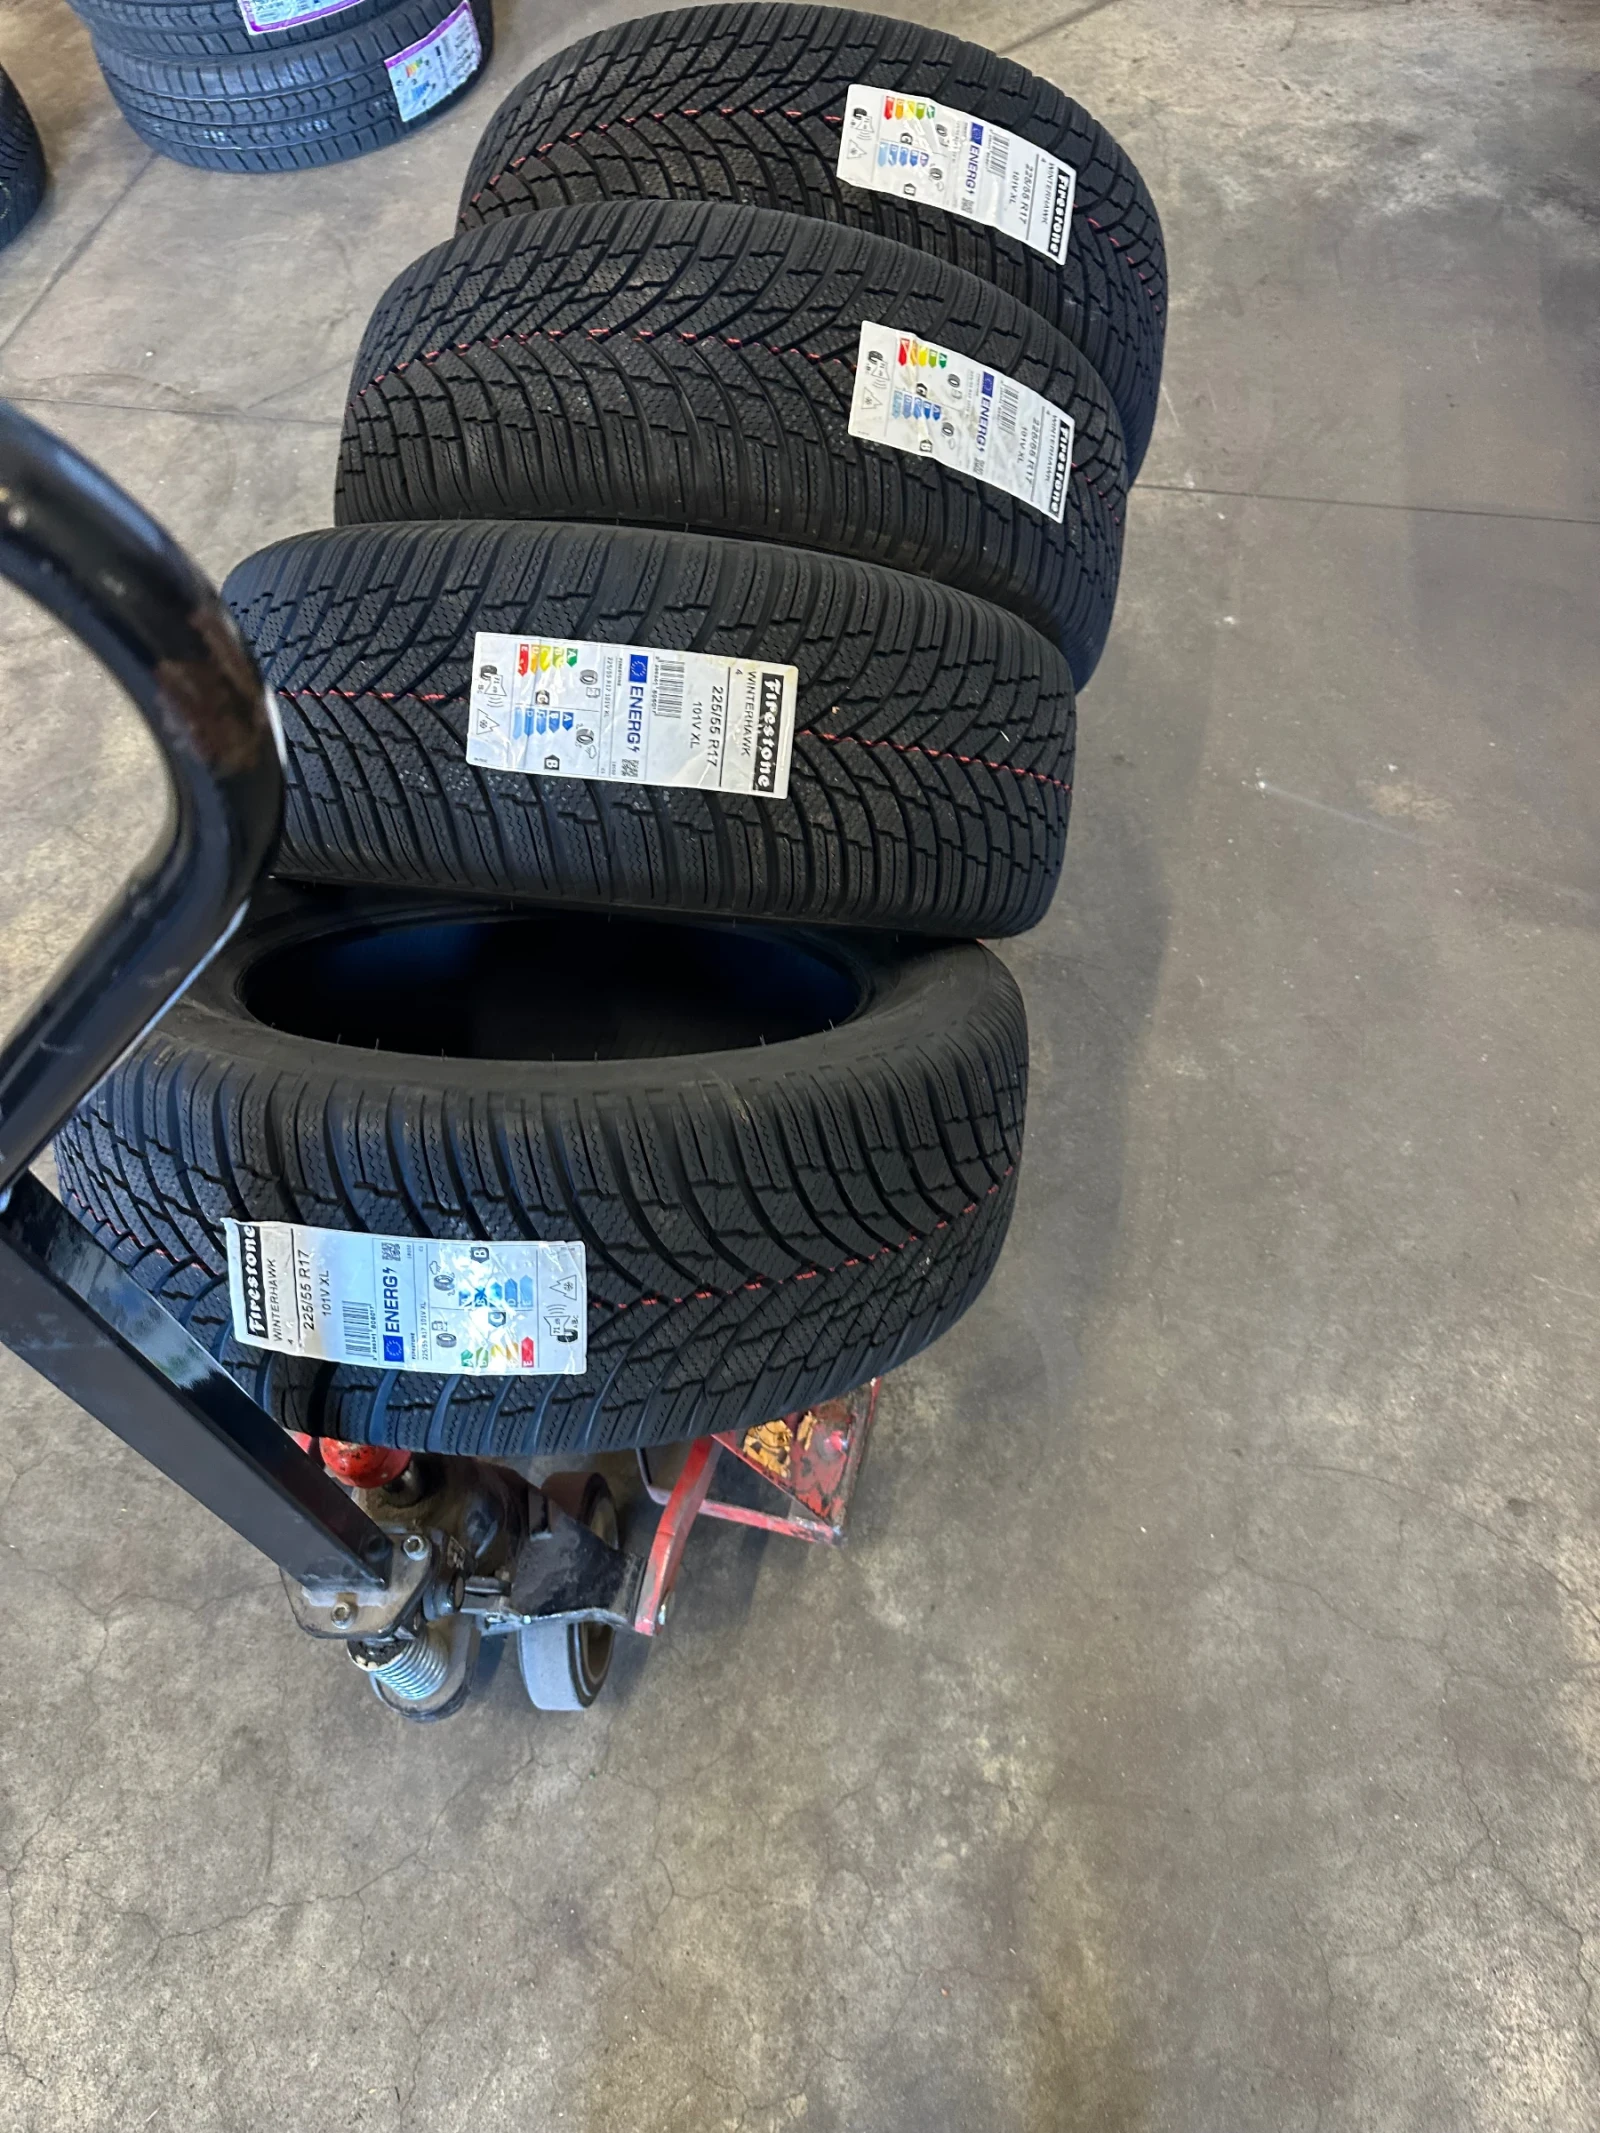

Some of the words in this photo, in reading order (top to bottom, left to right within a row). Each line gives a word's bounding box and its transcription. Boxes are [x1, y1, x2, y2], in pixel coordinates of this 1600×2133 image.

[1019, 203, 1029, 225] R17
[692, 701, 702, 728] 101V
[710, 686, 724, 734] 225/55
[741, 671, 756, 757] WINTERHAWK
[690, 733, 701, 749] XL
[757, 678, 783, 788] Firestone
[707, 739, 720, 767] R17
[298, 1249, 311, 1279] R17
[319, 1270, 329, 1287] XL
[243, 1225, 265, 1336] Firestone
[266, 1258, 282, 1342] WINTERHAWK
[300, 1284, 314, 1331] 225/55
[320, 1290, 332, 1316] 101V
